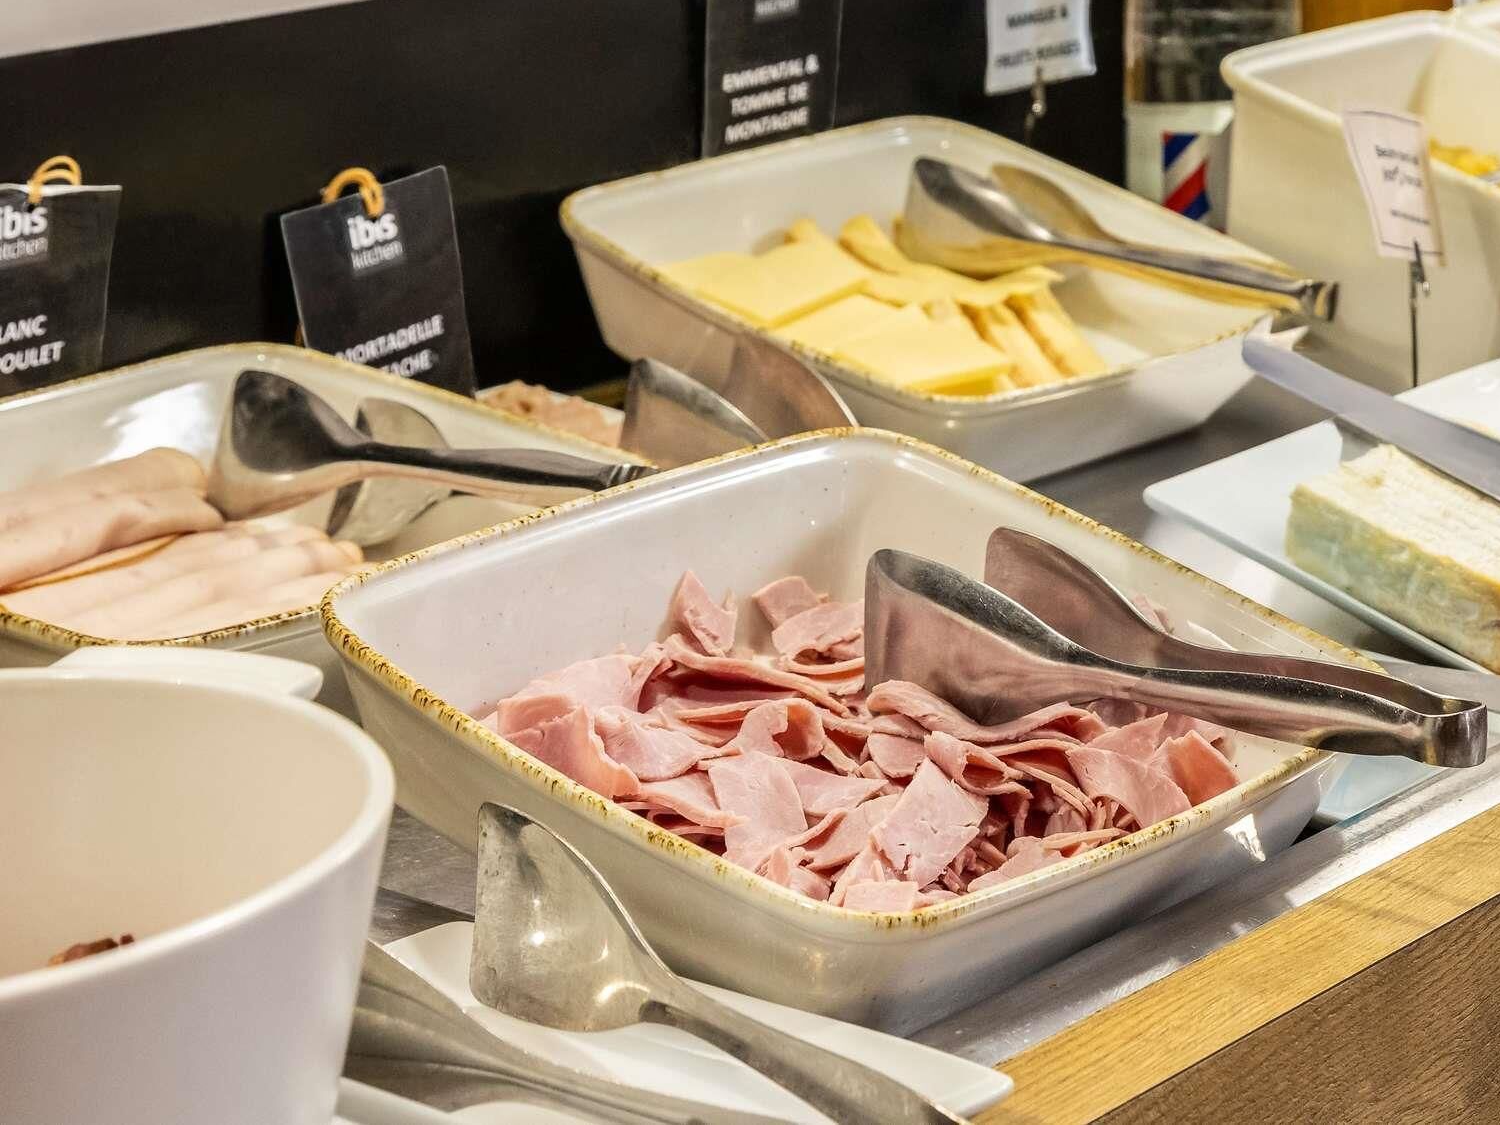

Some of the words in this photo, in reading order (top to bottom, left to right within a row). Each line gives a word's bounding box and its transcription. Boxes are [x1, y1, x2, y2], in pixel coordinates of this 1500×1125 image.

[347, 212, 399, 251] ibis
[0, 313, 48, 345] LANC
[0, 340, 66, 375] OULET
